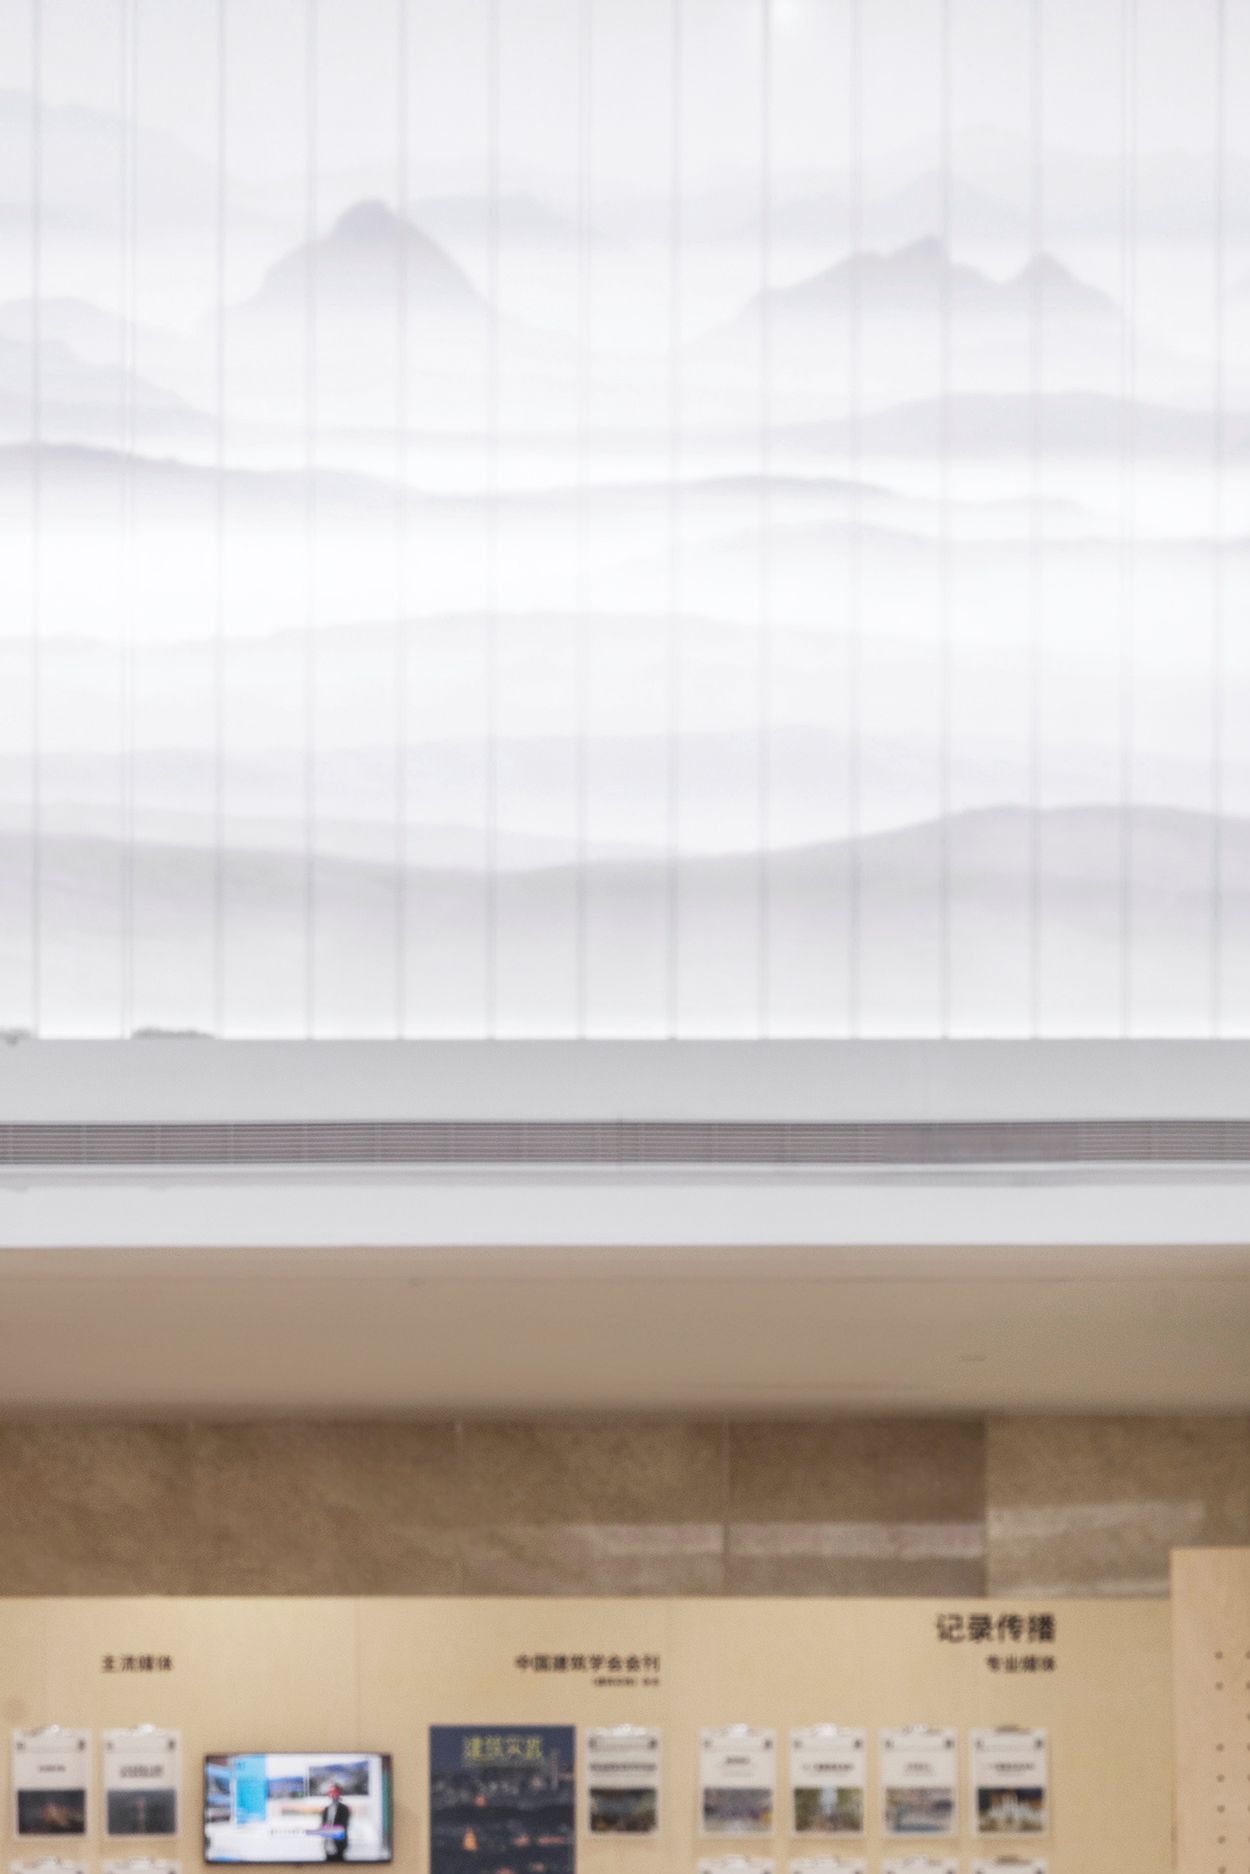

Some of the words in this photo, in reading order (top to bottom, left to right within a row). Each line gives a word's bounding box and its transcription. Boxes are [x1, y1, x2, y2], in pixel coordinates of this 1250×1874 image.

[936, 1613, 1055, 1643] 记录传播
[515, 1654, 661, 1672] 中国建筑学会会刊
